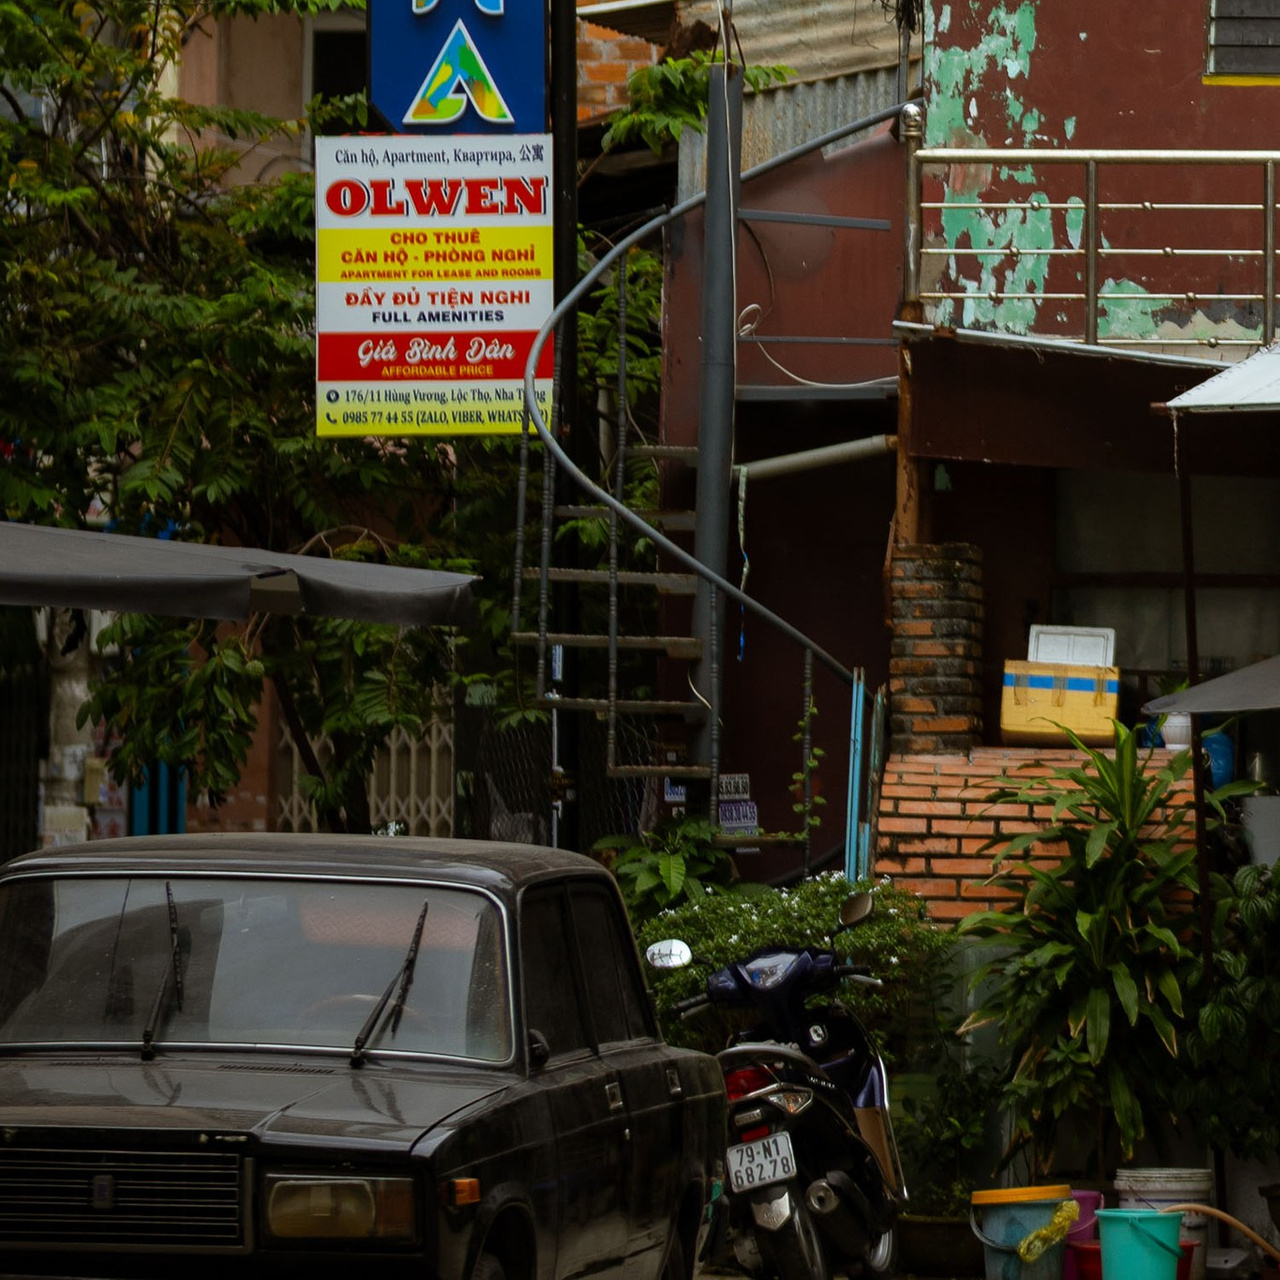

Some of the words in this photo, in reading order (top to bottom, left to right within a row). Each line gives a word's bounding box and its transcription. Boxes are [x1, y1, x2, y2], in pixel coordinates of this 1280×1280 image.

[335, 149, 357, 164] Căn
[361, 149, 379, 167] hộ,
[382, 149, 450, 166] Apartment,
[453, 149, 516, 166] Квартира,
[519, 143, 544, 162] 公寓
[325, 176, 549, 218] OLWEN
[390, 232, 428, 245] CHO
[433, 229, 480, 244] THUÊ
[341, 248, 378, 264] CĂN
[384, 248, 408, 266] HỘ
[424, 248, 485, 262] PHÒNG
[491, 244, 535, 262] NGHỈ
[341, 269, 407, 279] APARTMENT
[412, 269, 433, 279] FOR
[437, 269, 471, 279] LEASE
[475, 268, 498, 278] AND
[502, 268, 542, 278] ROOMS
[345, 287, 386, 306] ĐẦY
[392, 286, 421, 306] ĐỦ
[427, 288, 473, 309] TIỆN
[481, 290, 531, 306] NGHI
[372, 311, 411, 324] FULL
[416, 310, 504, 323] AMENITIES
[405, 336, 458, 364] Bình
[465, 337, 516, 364] Dân
[381, 365, 456, 376] AFFORDABLE
[459, 364, 493, 375] PRICE
[345, 390, 381, 404] 176/11
[384, 389, 410, 404] Hùng
[413, 389, 448, 405] Vương,
[451, 388, 467, 404] Lộc
[470, 388, 492, 403] Thọ,
[494, 388, 514, 400] Nha
[516, 387, 546, 403] Tng
[342, 411, 368, 423] 0985
[370, 411, 383, 423] 77
[385, 411, 398, 423] 44
[401, 411, 413, 423] 55
[416, 410, 449, 427] (ZALO,
[451, 410, 484, 425] VIBER,
[736, 1138, 780, 1167] 79-N1
[734, 1156, 791, 1188] 682.78
